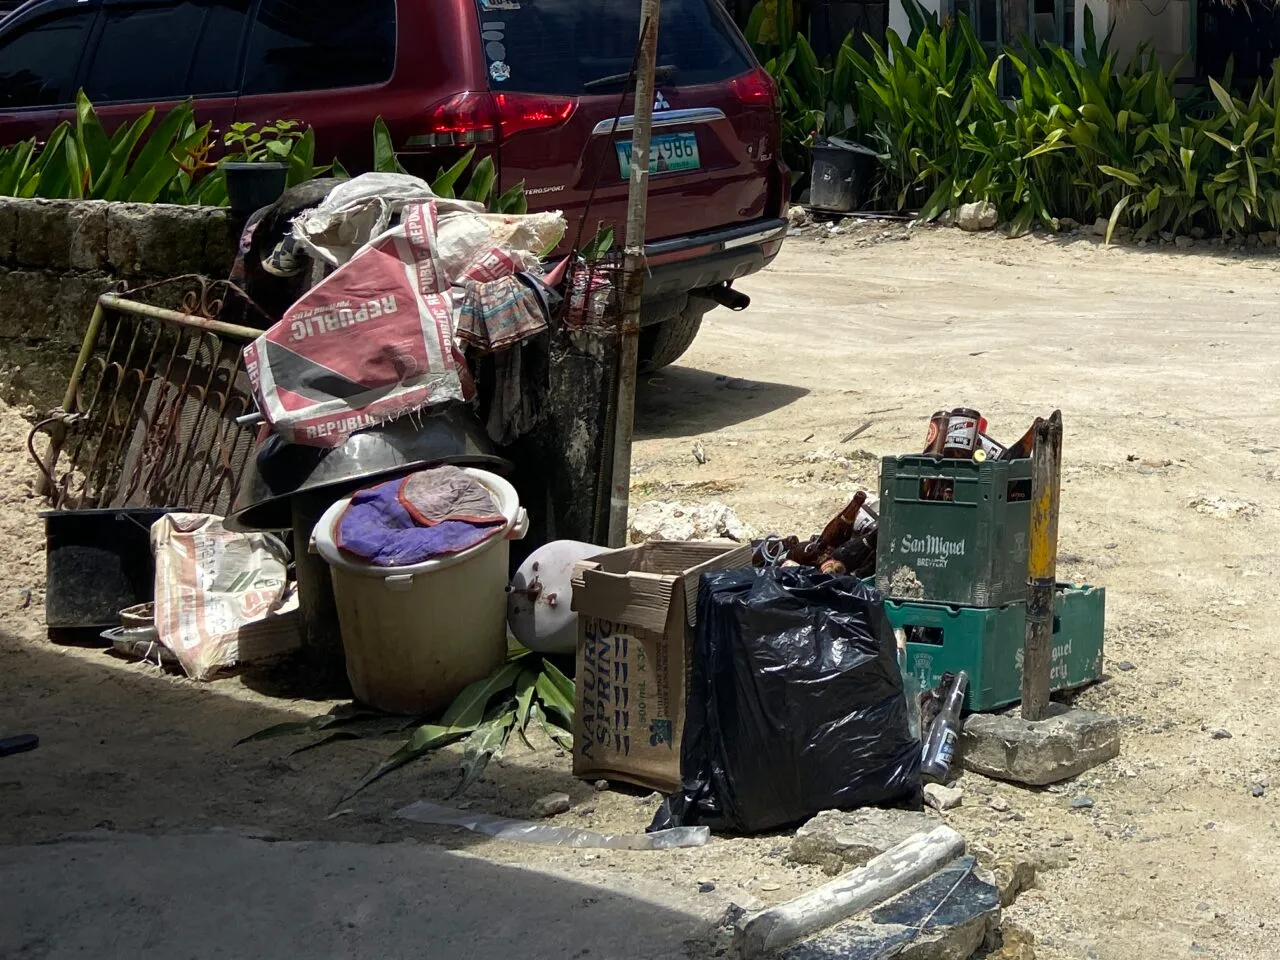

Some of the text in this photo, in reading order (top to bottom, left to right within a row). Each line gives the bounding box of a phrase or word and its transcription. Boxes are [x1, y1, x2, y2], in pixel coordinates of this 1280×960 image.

[663, 139, 693, 159] 986
[290, 295, 397, 341] REPUBLIC
[900, 534, 965, 560] San Miguel
[581, 619, 598, 760] NATURE
[638, 702, 647, 723] 500
